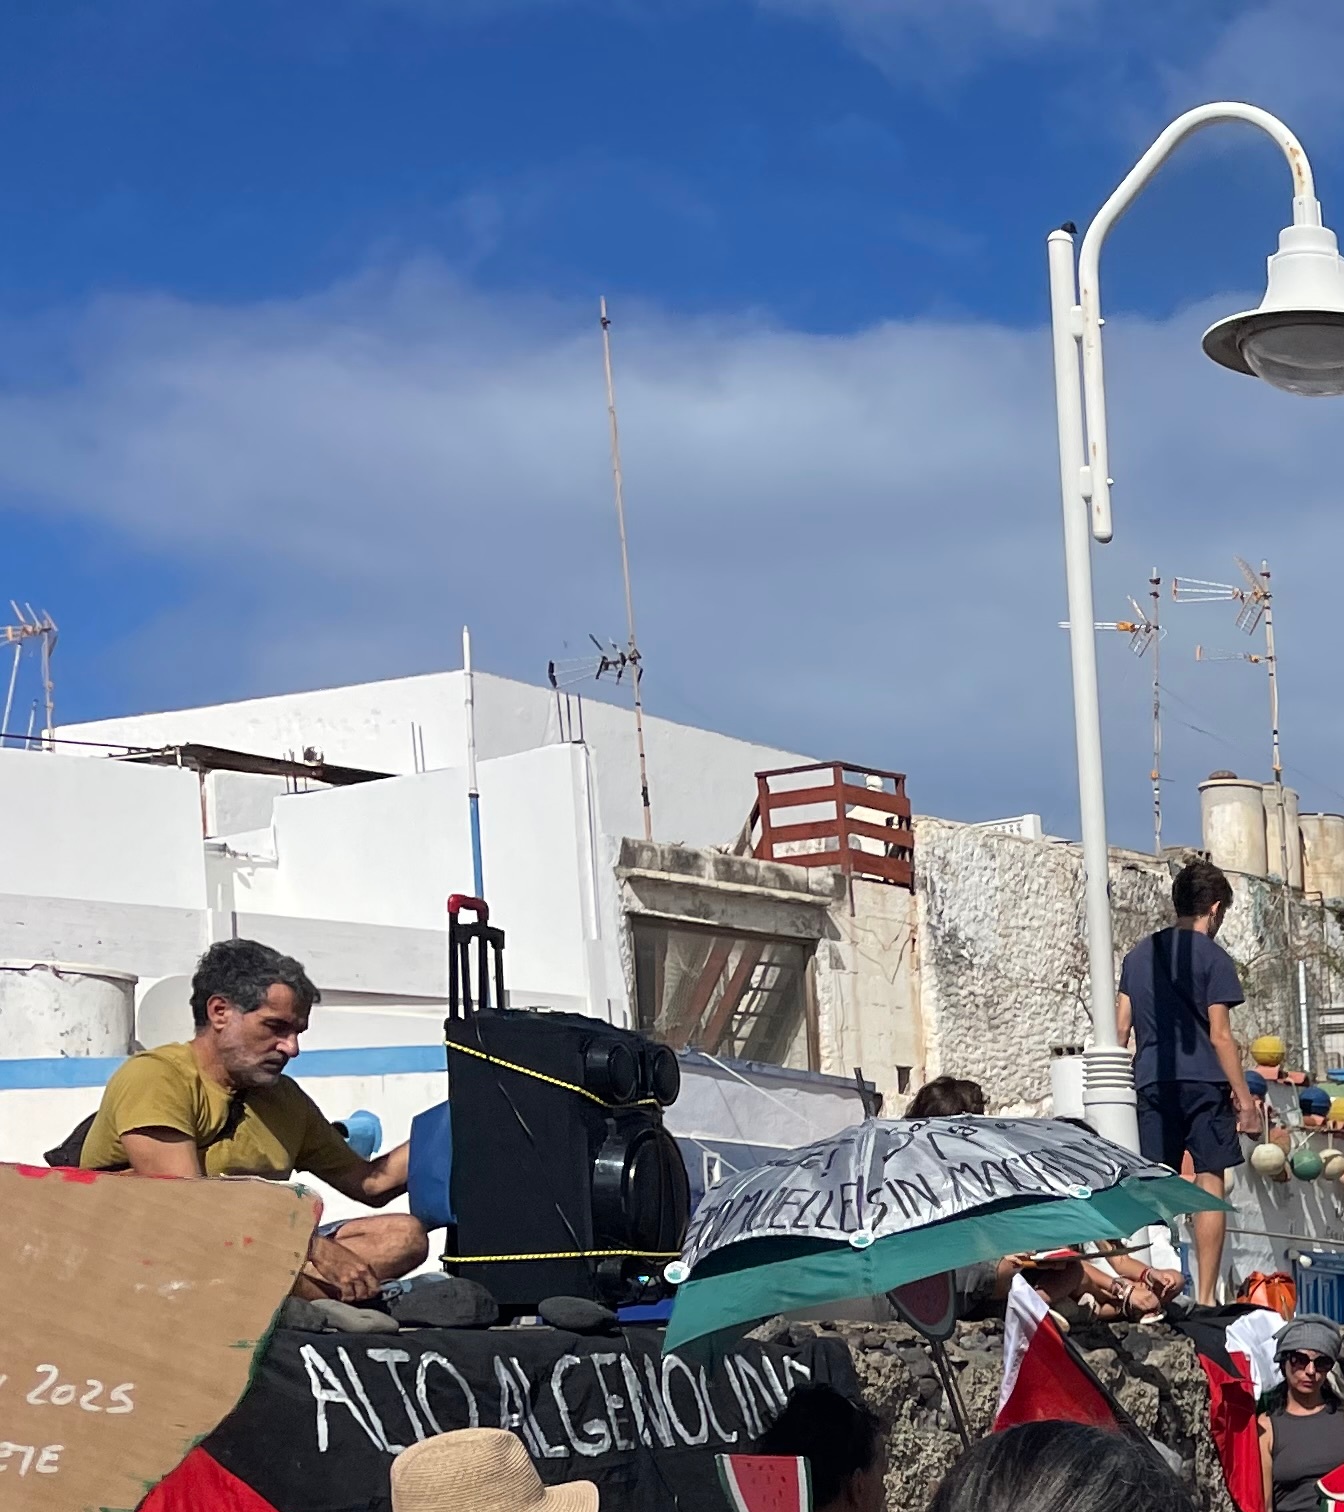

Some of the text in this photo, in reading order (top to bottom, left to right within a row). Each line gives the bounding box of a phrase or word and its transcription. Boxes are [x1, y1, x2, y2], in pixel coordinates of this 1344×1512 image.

[26, 1363, 136, 1414] 2025
[300, 1344, 479, 1455] ALTO
[493, 1354, 570, 1458] AL
